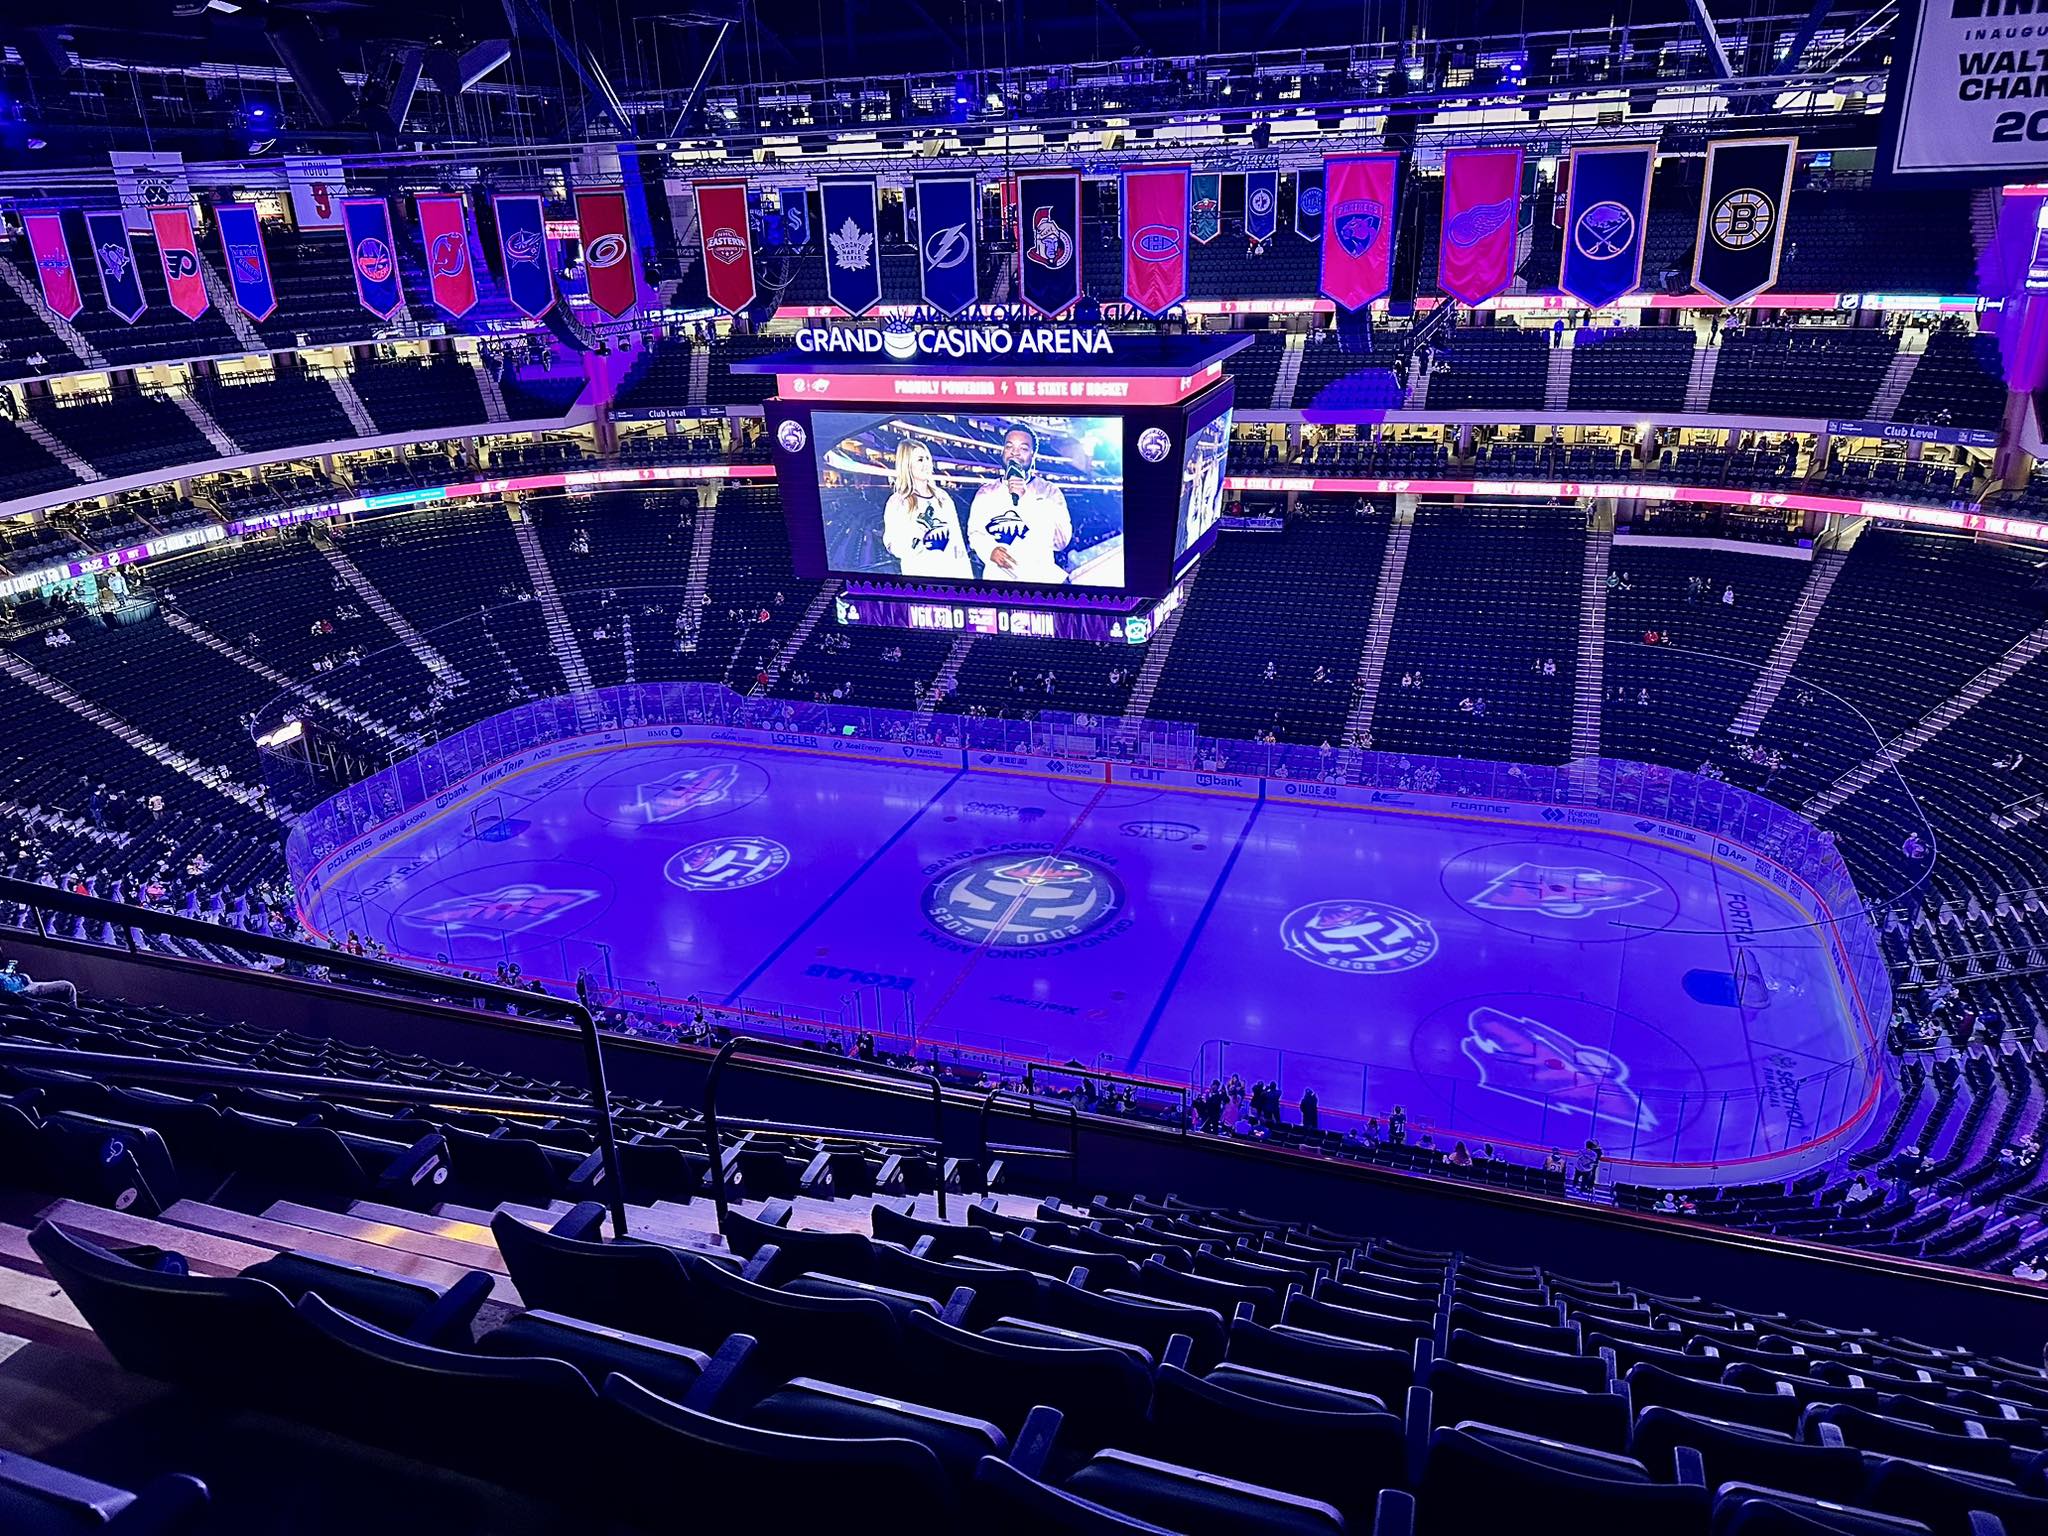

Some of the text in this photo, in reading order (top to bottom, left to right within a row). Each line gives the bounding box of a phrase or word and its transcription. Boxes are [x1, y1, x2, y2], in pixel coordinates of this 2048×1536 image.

[1959, 49, 2048, 76] WALT
[311, 181, 331, 219] 9
[1337, 204, 1379, 214] PANTHERS
[1729, 202, 1757, 236] B
[707, 237, 745, 247] EASTERN
[837, 242, 865, 251] TORONTO
[795, 328, 1113, 357] GRAND CASINO ARENA
[894, 380, 1129, 397] PROUDLY POWERING THE STATE OF HOCKEY
[648, 409, 686, 419] Club Level
[1884, 425, 1938, 440] Club Level
[911, 607, 934, 628] VGK
[954, 609, 965, 629] 0
[998, 612, 1009, 631] 0
[1031, 615, 1055, 637] MIN
[648, 729, 668, 737] BMO
[772, 733, 818, 746] LOFFLER
[916, 748, 944, 756] FANDUEL
[1066, 767, 1093, 776] Hospital
[1298, 784, 1321, 795] IUOE
[1323, 787, 1337, 797] 49
[1451, 801, 1511, 814] FORTINET
[1567, 808, 1599, 818] Regions
[379, 811, 427, 841] GRAND CASINO
[1567, 815, 1601, 825] Hospital
[326, 838, 373, 873] POLARIS
[921, 842, 1120, 877] GRAND CASINO ARENA
[929, 907, 1083, 945] 2000 2025
[985, 948, 1064, 960] CASINO
[1327, 940, 1432, 971] 2000 2025
[803, 963, 916, 991] ECOLAB
